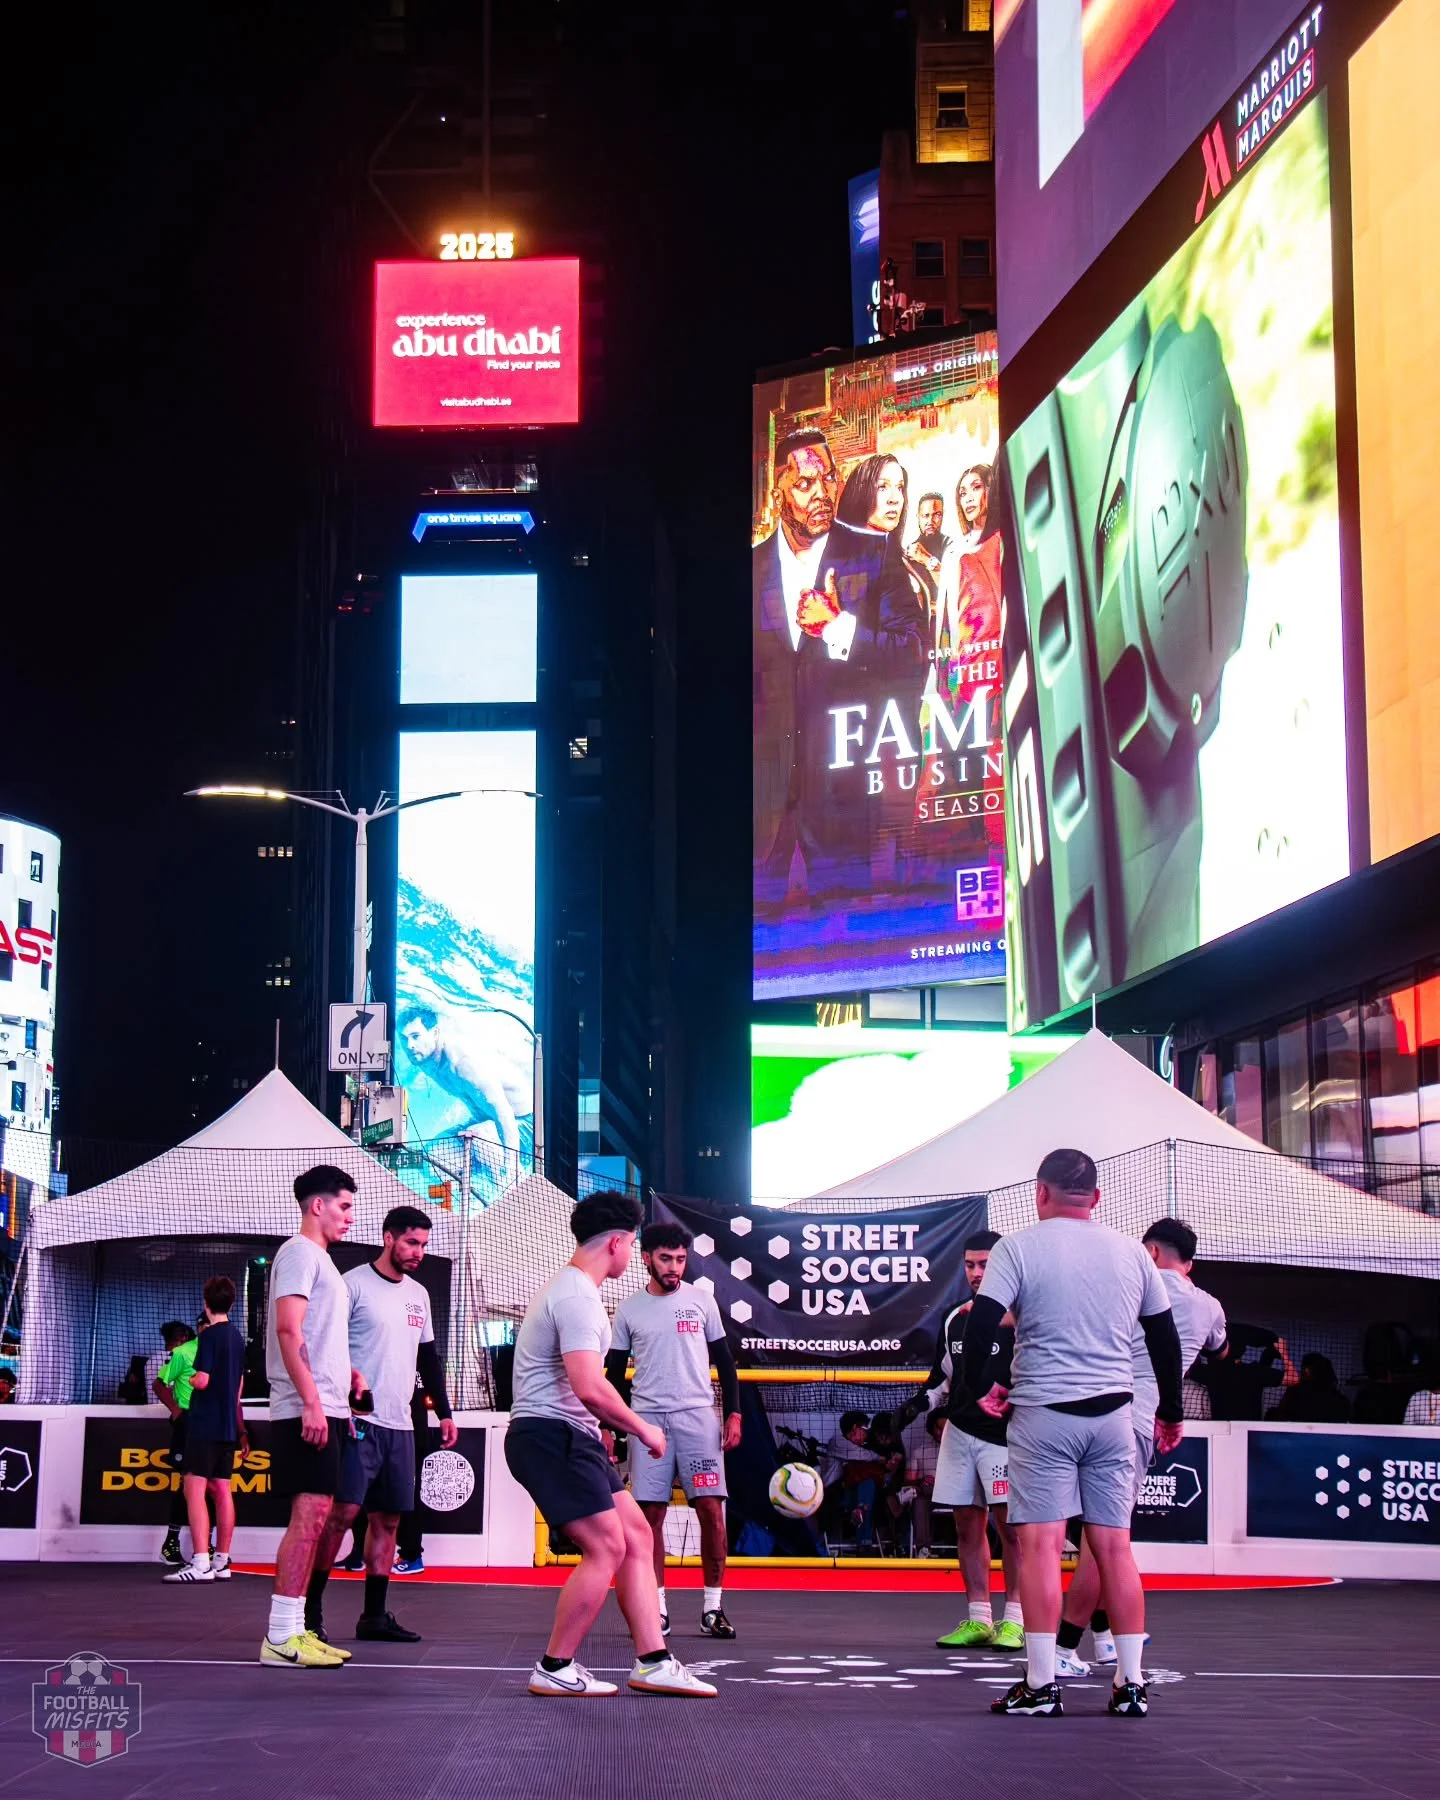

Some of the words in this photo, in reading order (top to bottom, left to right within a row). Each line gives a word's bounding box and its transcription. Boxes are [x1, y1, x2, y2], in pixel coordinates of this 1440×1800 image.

[1237, 4, 1323, 127] MARRIOTT
[1237, 58, 1312, 163] MARQUIS
[439, 232, 515, 260] 2025
[396, 312, 486, 330] experience
[392, 328, 458, 357] abu
[487, 360, 510, 370] Find
[511, 360, 533, 371] your
[427, 515, 449, 523] one
[449, 513, 481, 523] times
[483, 514, 521, 524] square
[953, 660, 998, 684] THE
[827, 684, 1004, 770] FAM
[867, 752, 1004, 795] BUSIN
[918, 793, 1000, 819] SEASO
[910, 940, 991, 959] STREAMING
[338, 1052, 375, 1065] ONLY
[380, 1154, 390, 1167] W
[396, 1154, 409, 1168] 45
[801, 1224, 920, 1251] STREET
[801, 1256, 931, 1283] SOCCER
[801, 1289, 871, 1316] USA
[740, 1337, 902, 1352] STREETSOCCERUSA.ORG
[1382, 1459, 1440, 1480] STRE
[1137, 1495, 1176, 1506] BEGIN.
[1382, 1501, 1430, 1522] USA
